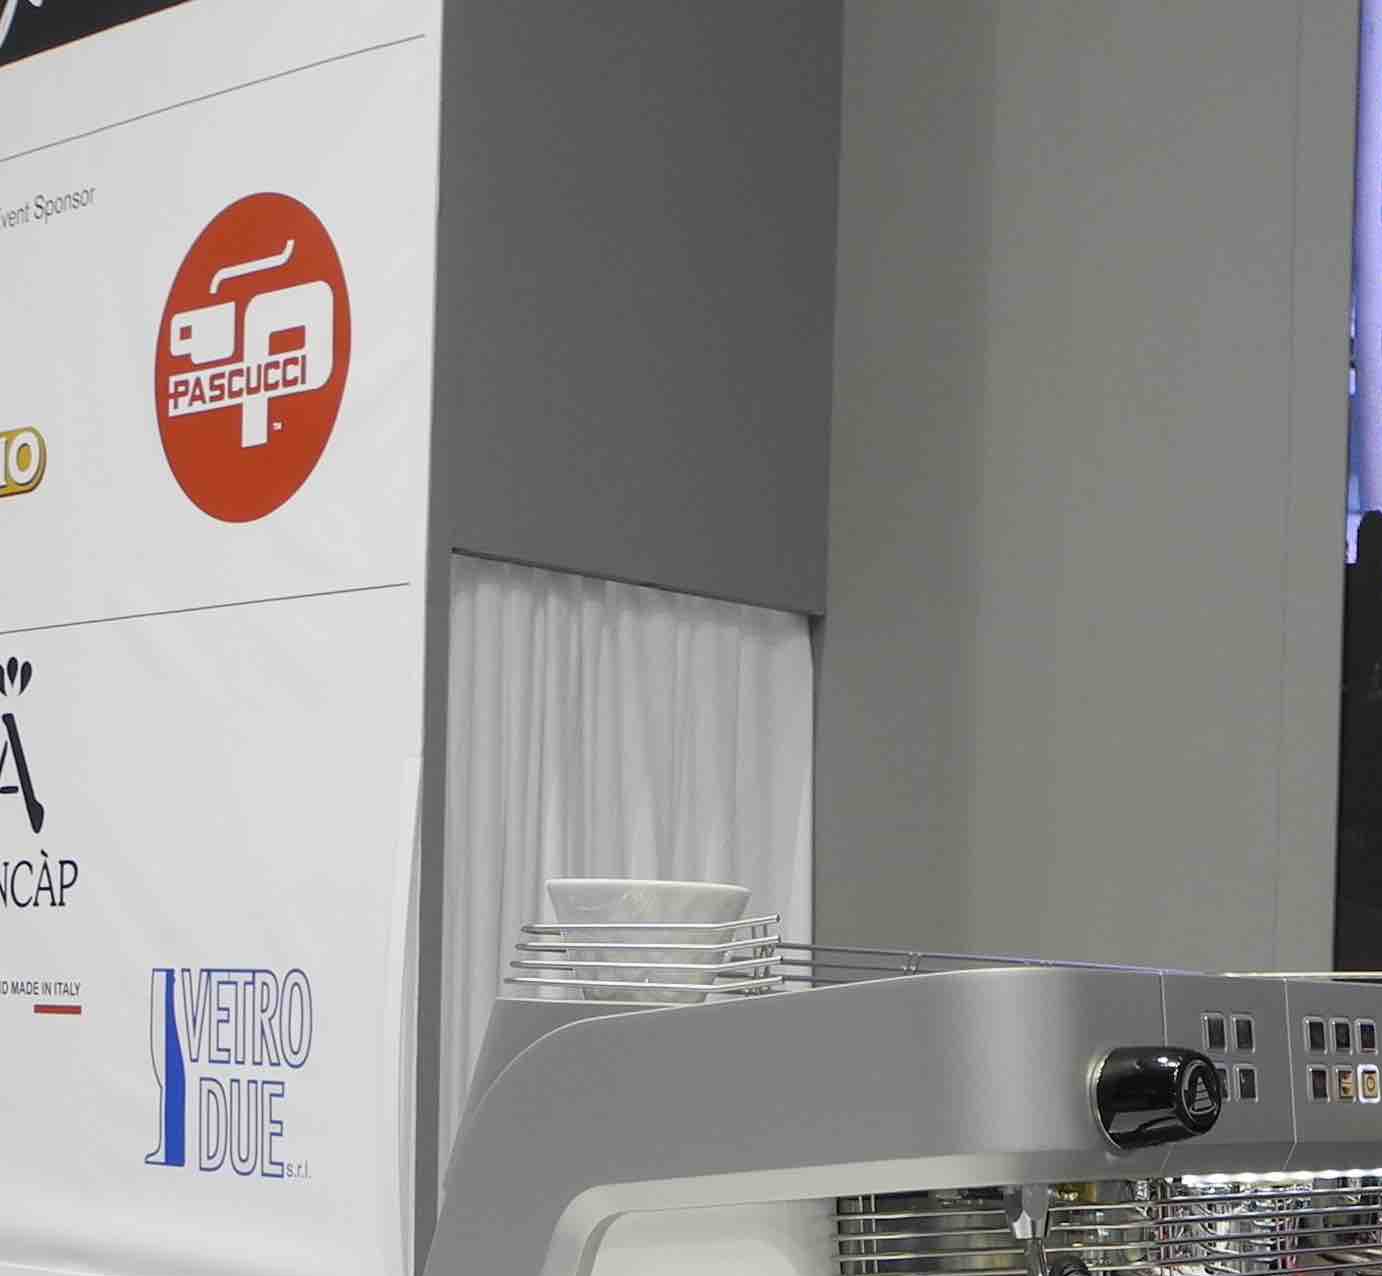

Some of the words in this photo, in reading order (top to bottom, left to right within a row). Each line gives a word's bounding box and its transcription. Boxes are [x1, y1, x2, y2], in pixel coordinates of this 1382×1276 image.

[33, 186, 96, 225] Sponsor
[168, 353, 307, 411] PASCUCCI
[11, 980, 39, 996] MADE
[42, 981, 52, 996] IN
[54, 980, 81, 997] ITALY
[180, 967, 313, 1070] VETRO
[199, 1076, 286, 1179] DUE
[286, 1159, 313, 1180] s.r.l.
